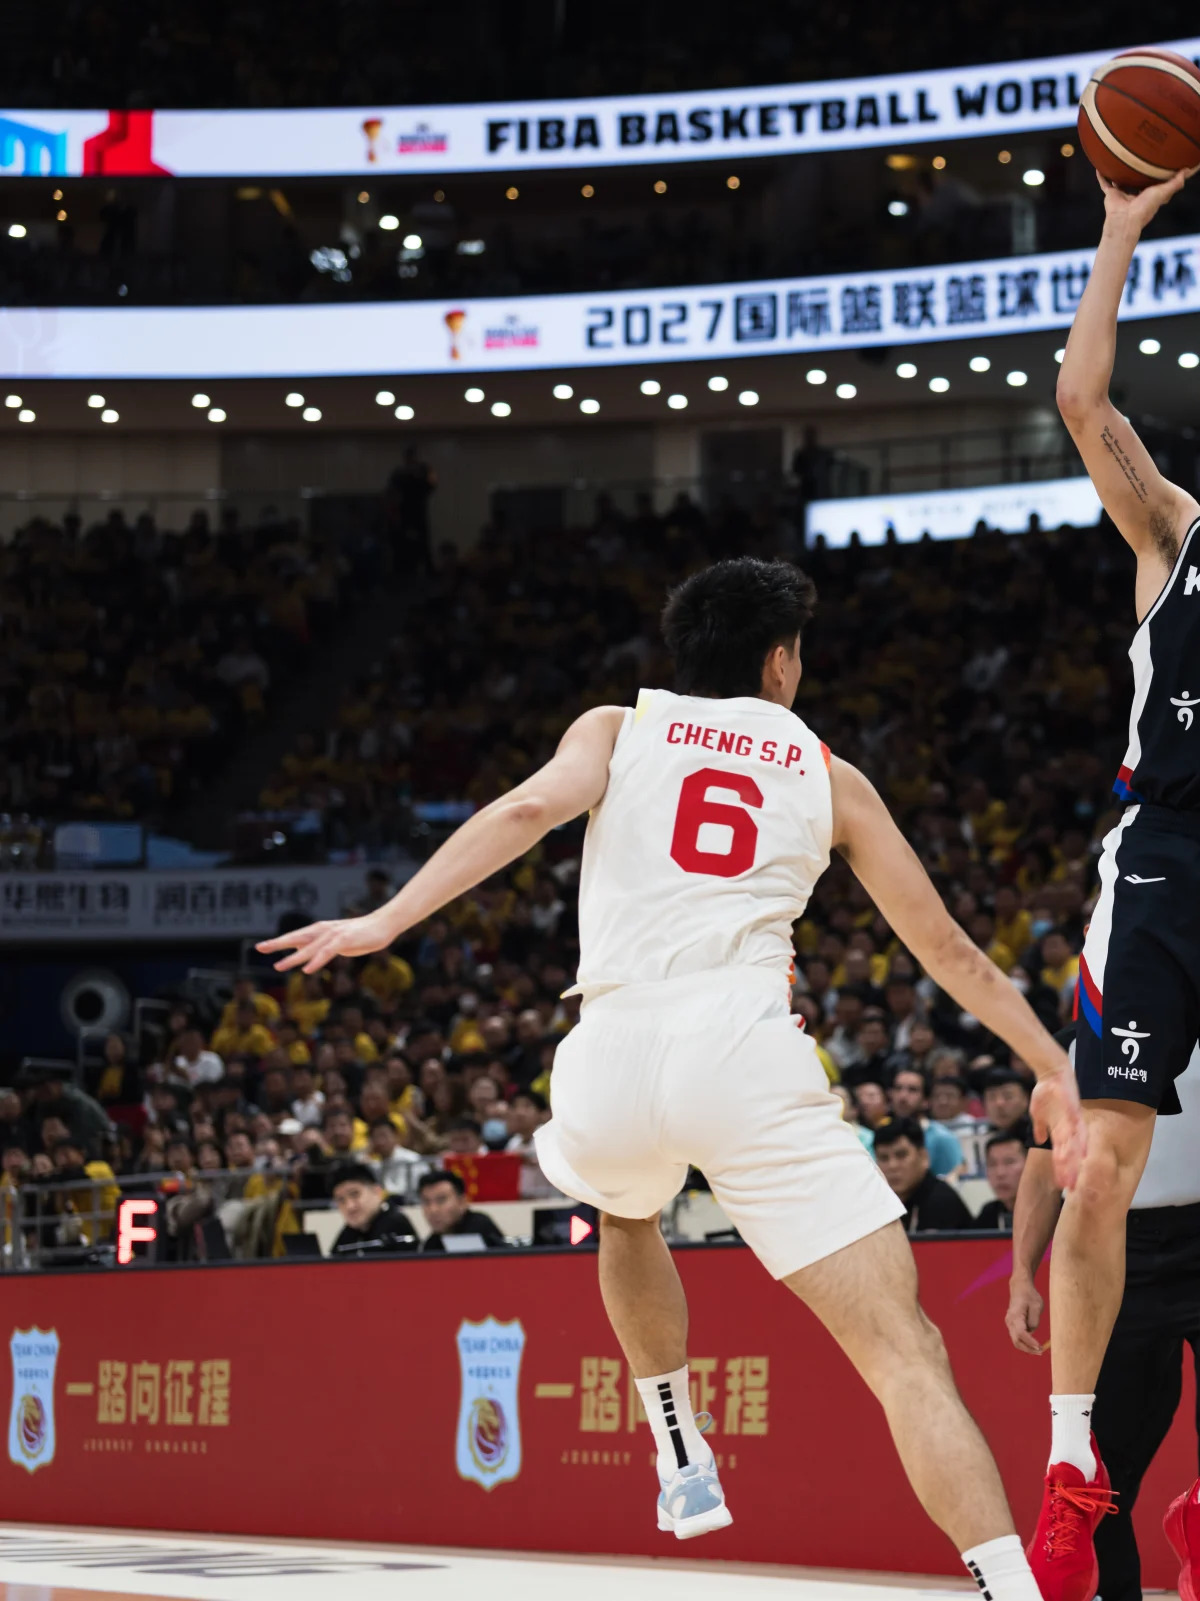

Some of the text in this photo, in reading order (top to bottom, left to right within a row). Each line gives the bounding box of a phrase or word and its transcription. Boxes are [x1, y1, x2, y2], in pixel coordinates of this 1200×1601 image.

[486, 116, 600, 153] FIBA
[618, 88, 939, 146] BASKETBALL
[955, 72, 1082, 118] WORL
[666, 722, 806, 776] CHENG S.P.
[670, 767, 764, 878] 6
[1107, 1065, 1148, 1083] 하나은행
[118, 1199, 158, 1265] F
[66, 1359, 231, 1425] 一路向征程
